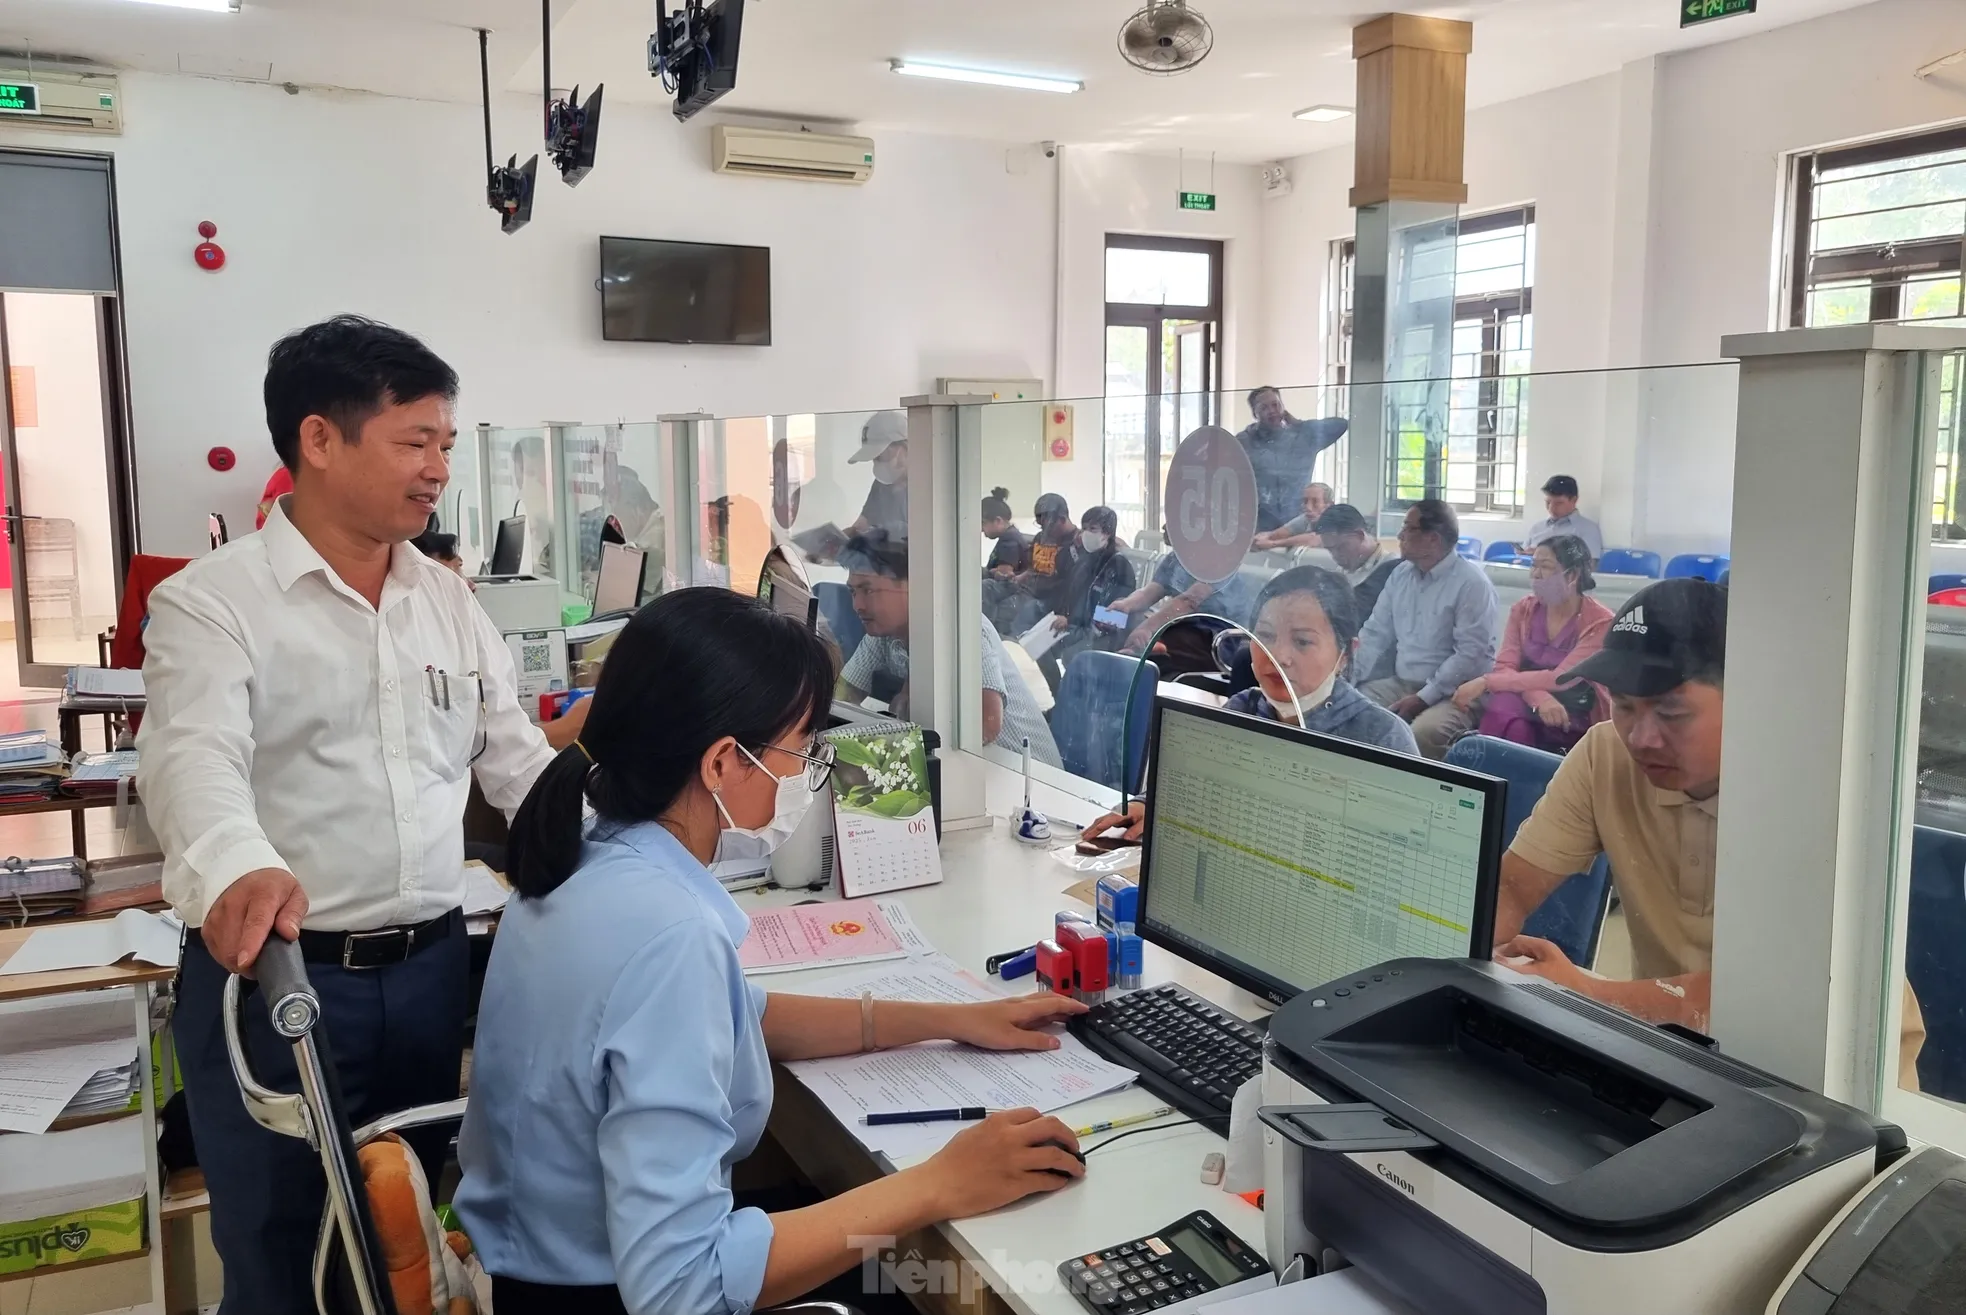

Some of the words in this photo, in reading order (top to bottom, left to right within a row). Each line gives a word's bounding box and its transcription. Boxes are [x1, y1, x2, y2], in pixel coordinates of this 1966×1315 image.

[1726, 0, 1747, 10] EXIT
[0, 86, 19, 97] IT
[1187, 194, 1208, 202] EXIT
[1612, 621, 1648, 635] adidas
[908, 818, 927, 835] 06
[1268, 991, 1284, 1004] DELL
[1376, 1162, 1415, 1196] Canon
[1196, 1215, 1212, 1229] CASIO
[0, 1225, 62, 1260] plus
